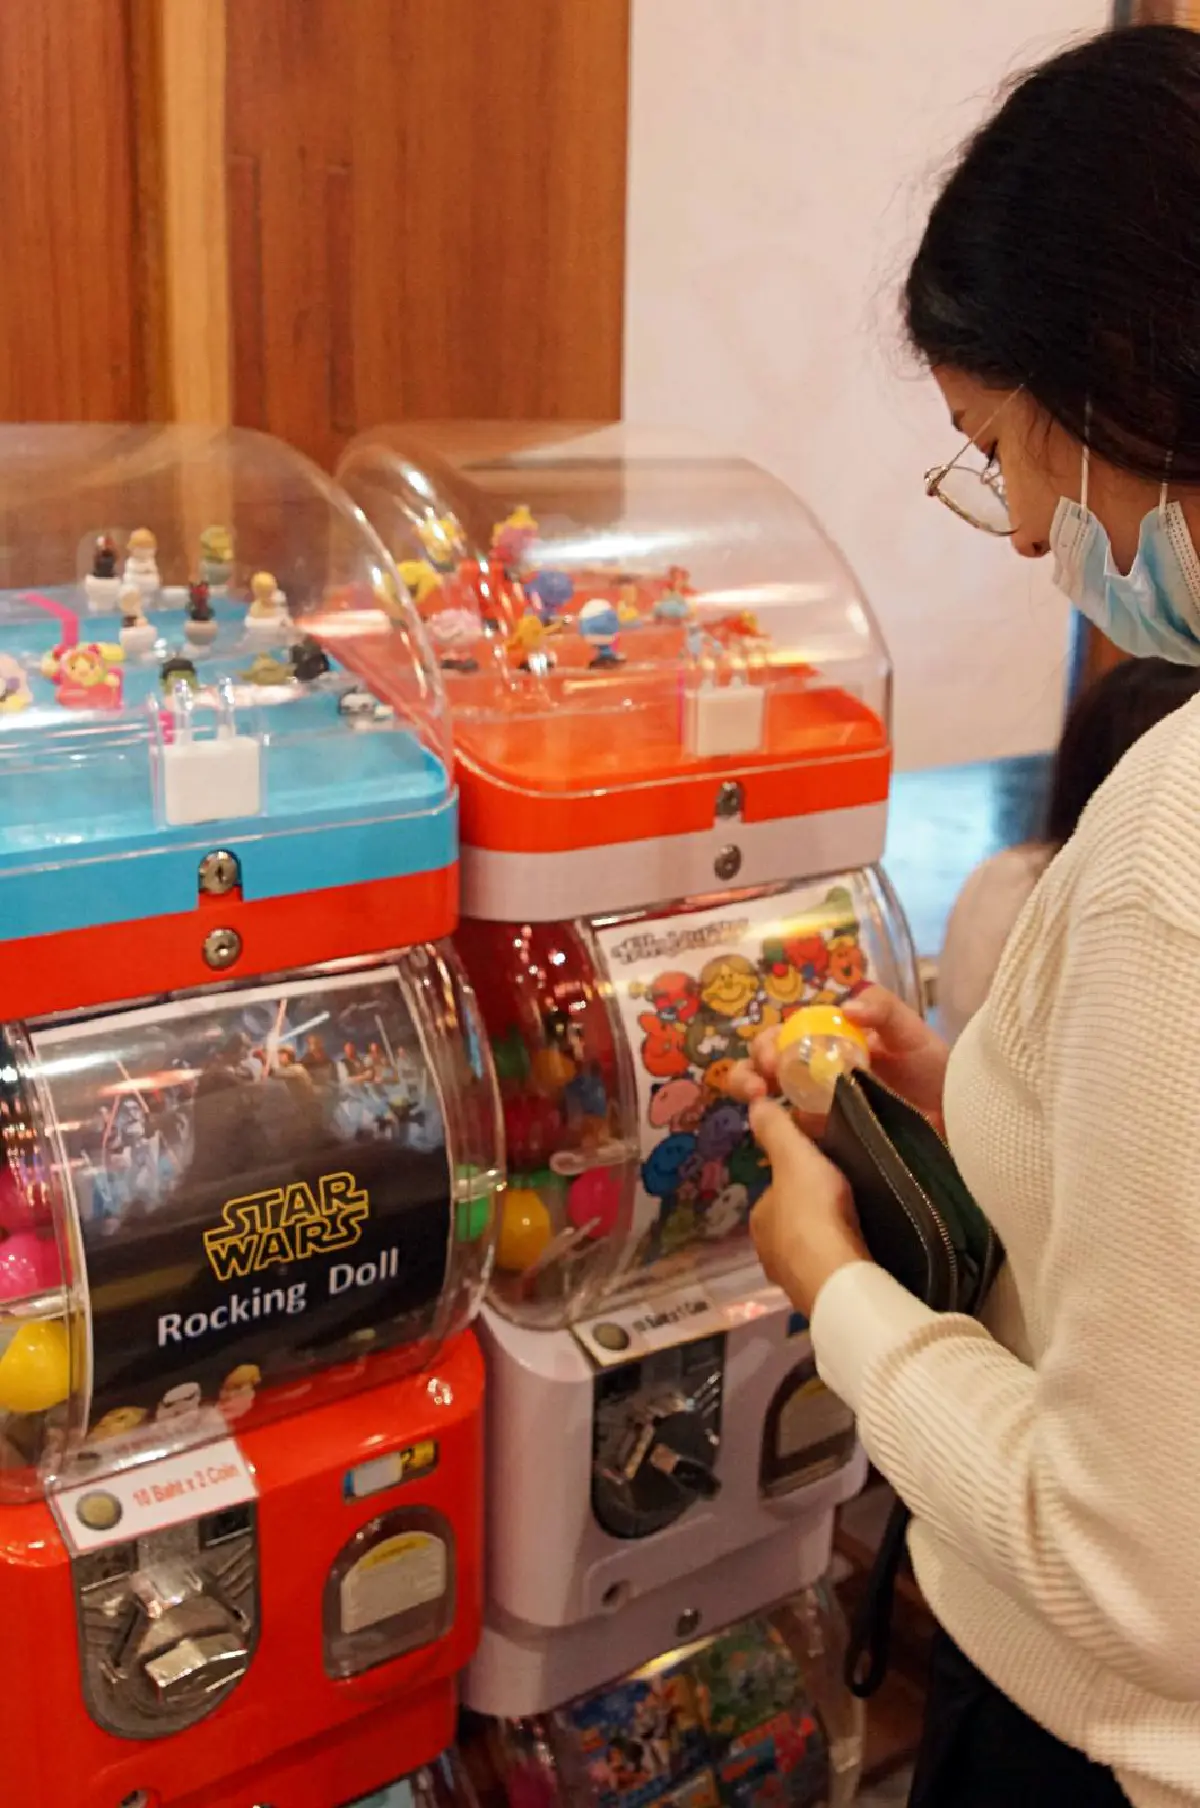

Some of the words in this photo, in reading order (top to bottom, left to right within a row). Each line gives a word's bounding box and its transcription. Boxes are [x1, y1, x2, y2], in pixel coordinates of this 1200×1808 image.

[203, 1171, 369, 1244] STAR
[204, 1206, 369, 1282] WARS
[157, 1282, 308, 1347] Rocking
[329, 1247, 398, 1294] Doll
